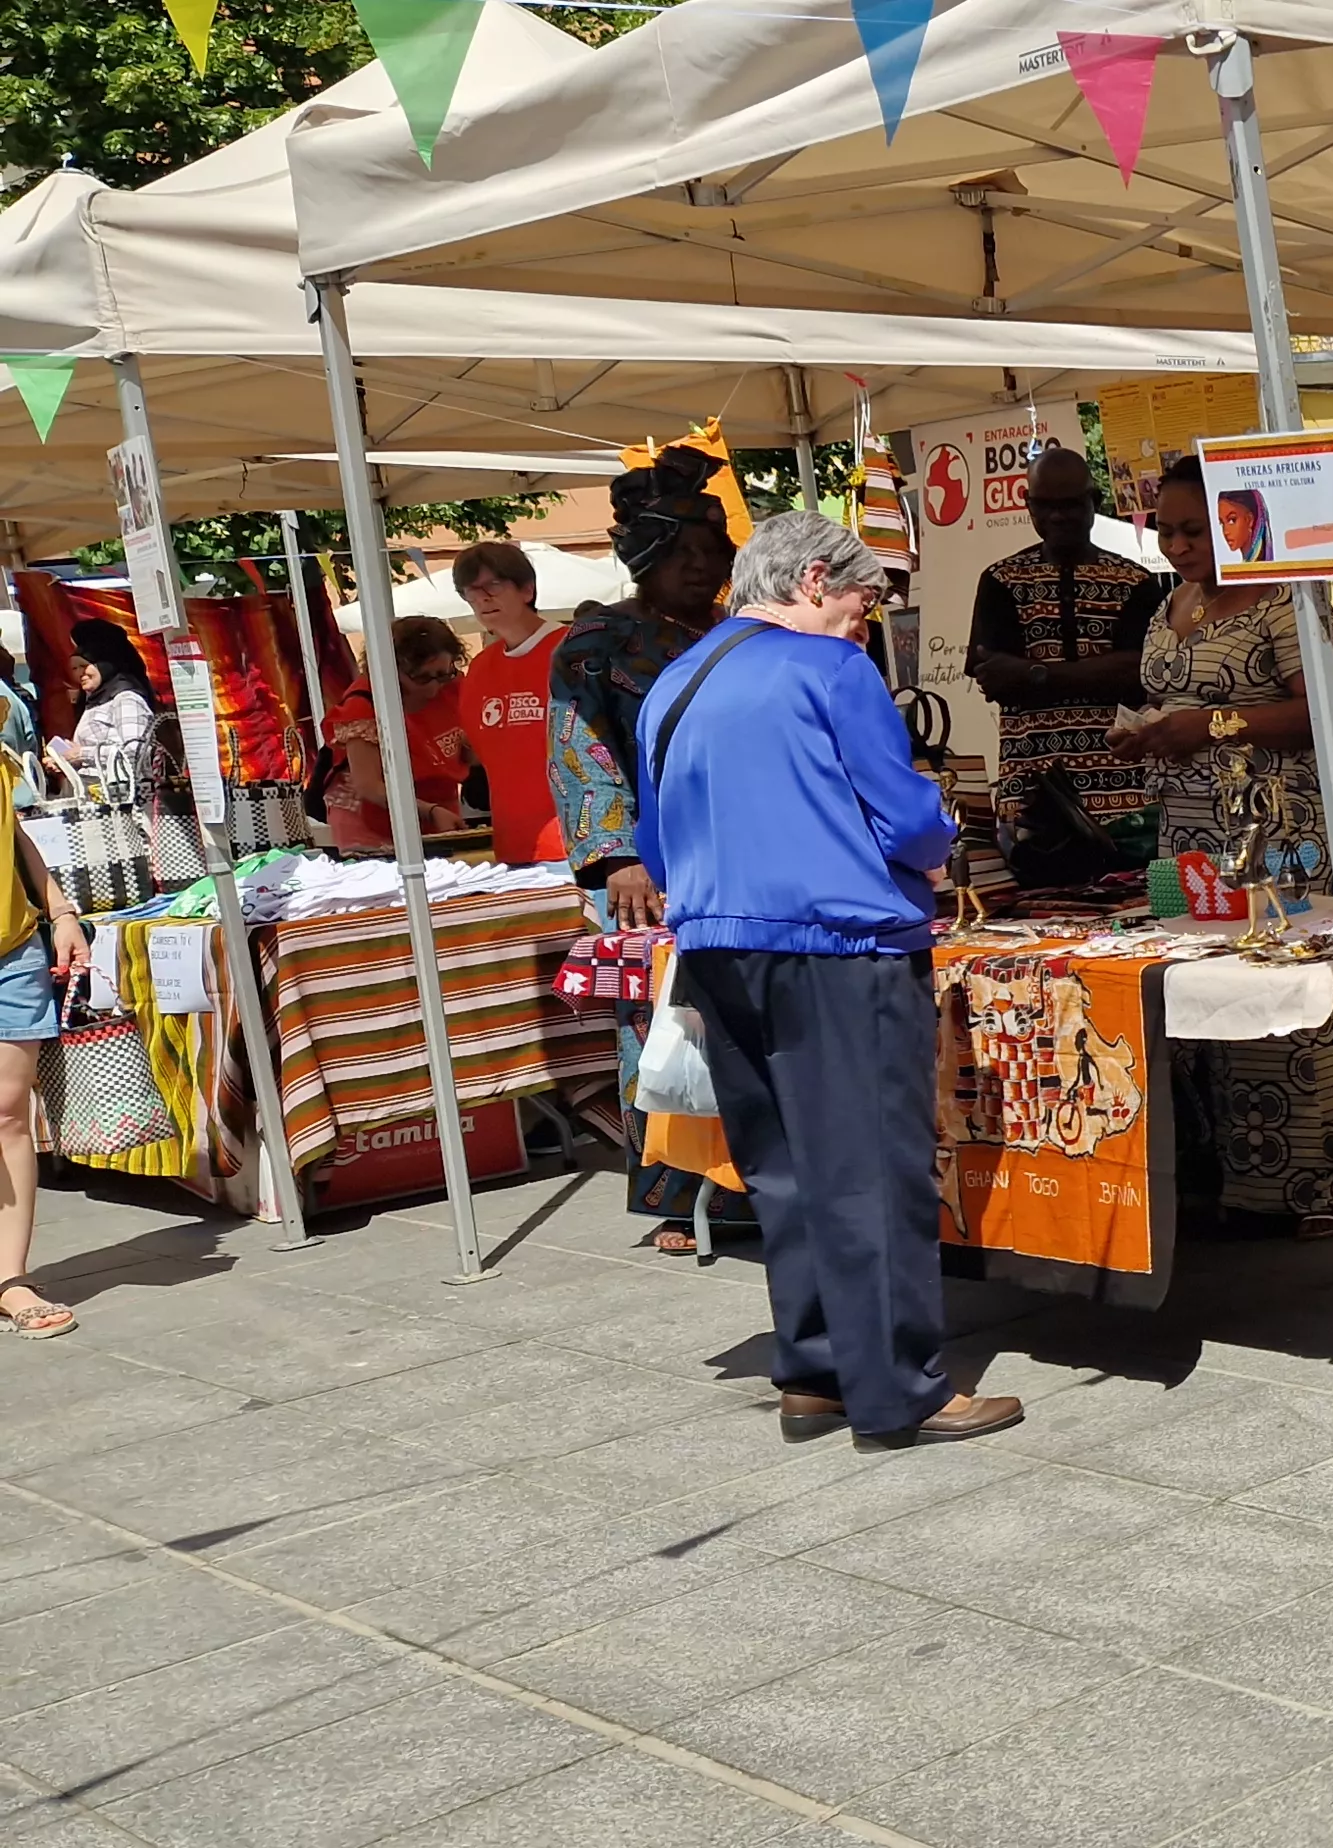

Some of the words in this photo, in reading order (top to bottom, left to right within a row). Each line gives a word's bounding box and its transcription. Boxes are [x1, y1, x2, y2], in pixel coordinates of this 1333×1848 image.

[985, 437, 1062, 474] BOS
[1235, 463, 1273, 478] TRENZAS
[1276, 460, 1322, 474] AFRICANAS
[1268, 479, 1282, 488] ARTE
[1290, 477, 1315, 486] CULTURA
[986, 478, 1029, 510] GLO
[1013, 515, 1031, 526] SALE
[509, 696, 540, 707] OSCO
[509, 708, 541, 720] LOBAL
[1024, 1171, 1060, 1197] TOGO
